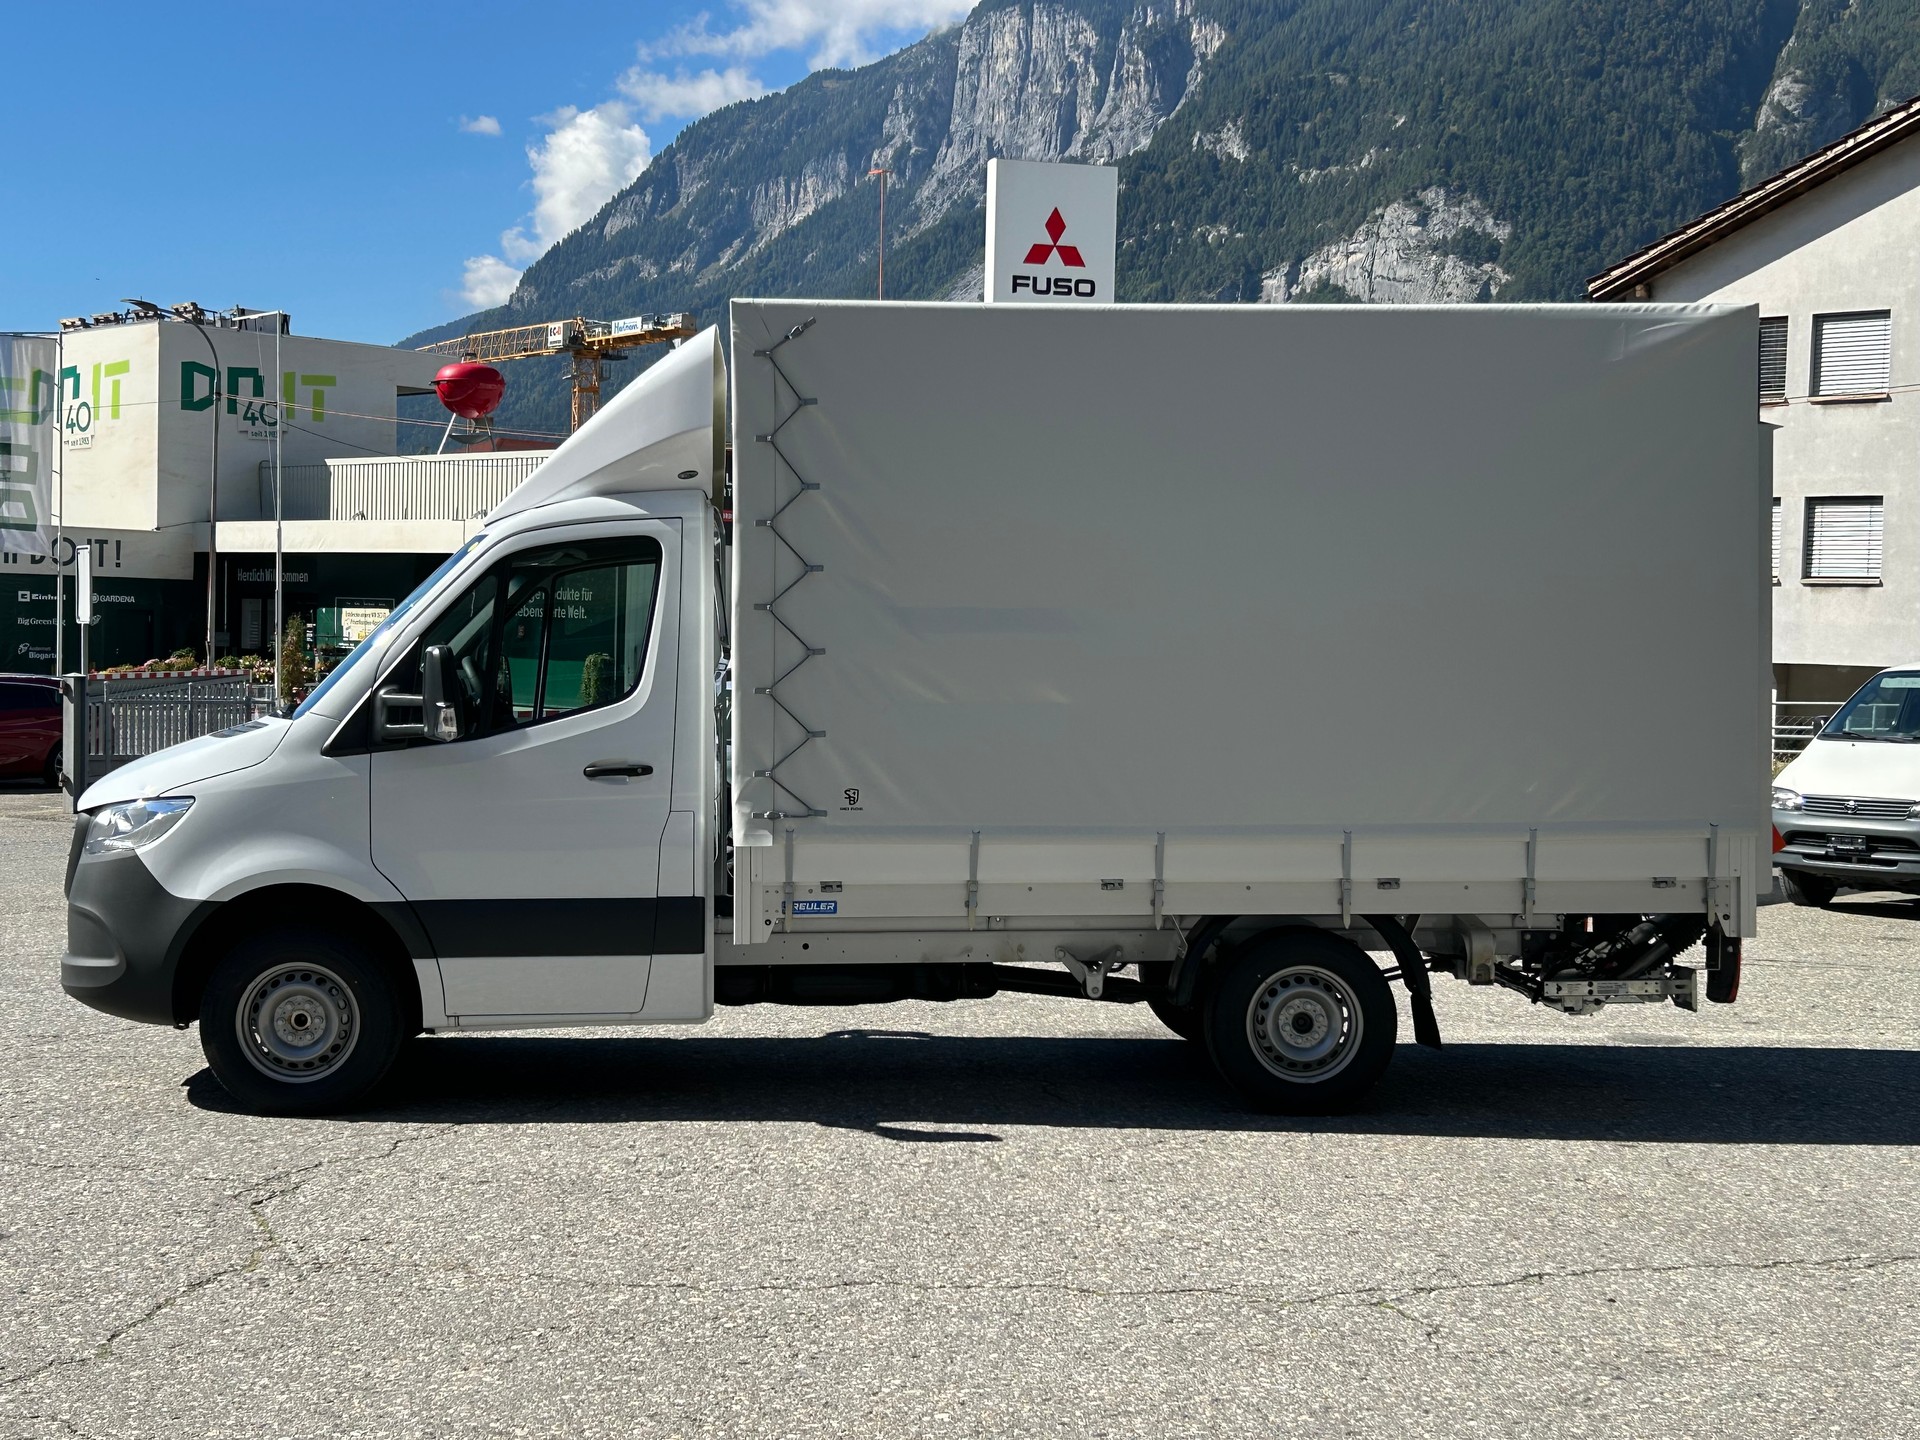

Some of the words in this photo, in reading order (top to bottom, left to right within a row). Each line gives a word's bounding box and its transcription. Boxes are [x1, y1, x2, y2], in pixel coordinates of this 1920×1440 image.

[1012, 275, 1095, 297] FUSO
[283, 371, 336, 422] IT
[65, 401, 91, 434] 40
[237, 568, 264, 582] Herzlich
[100, 594, 136, 603] GARDENA
[581, 587, 593, 602] für
[567, 605, 587, 619] Welt.
[30, 617, 52, 625] Green
[793, 902, 835, 911] REULER
